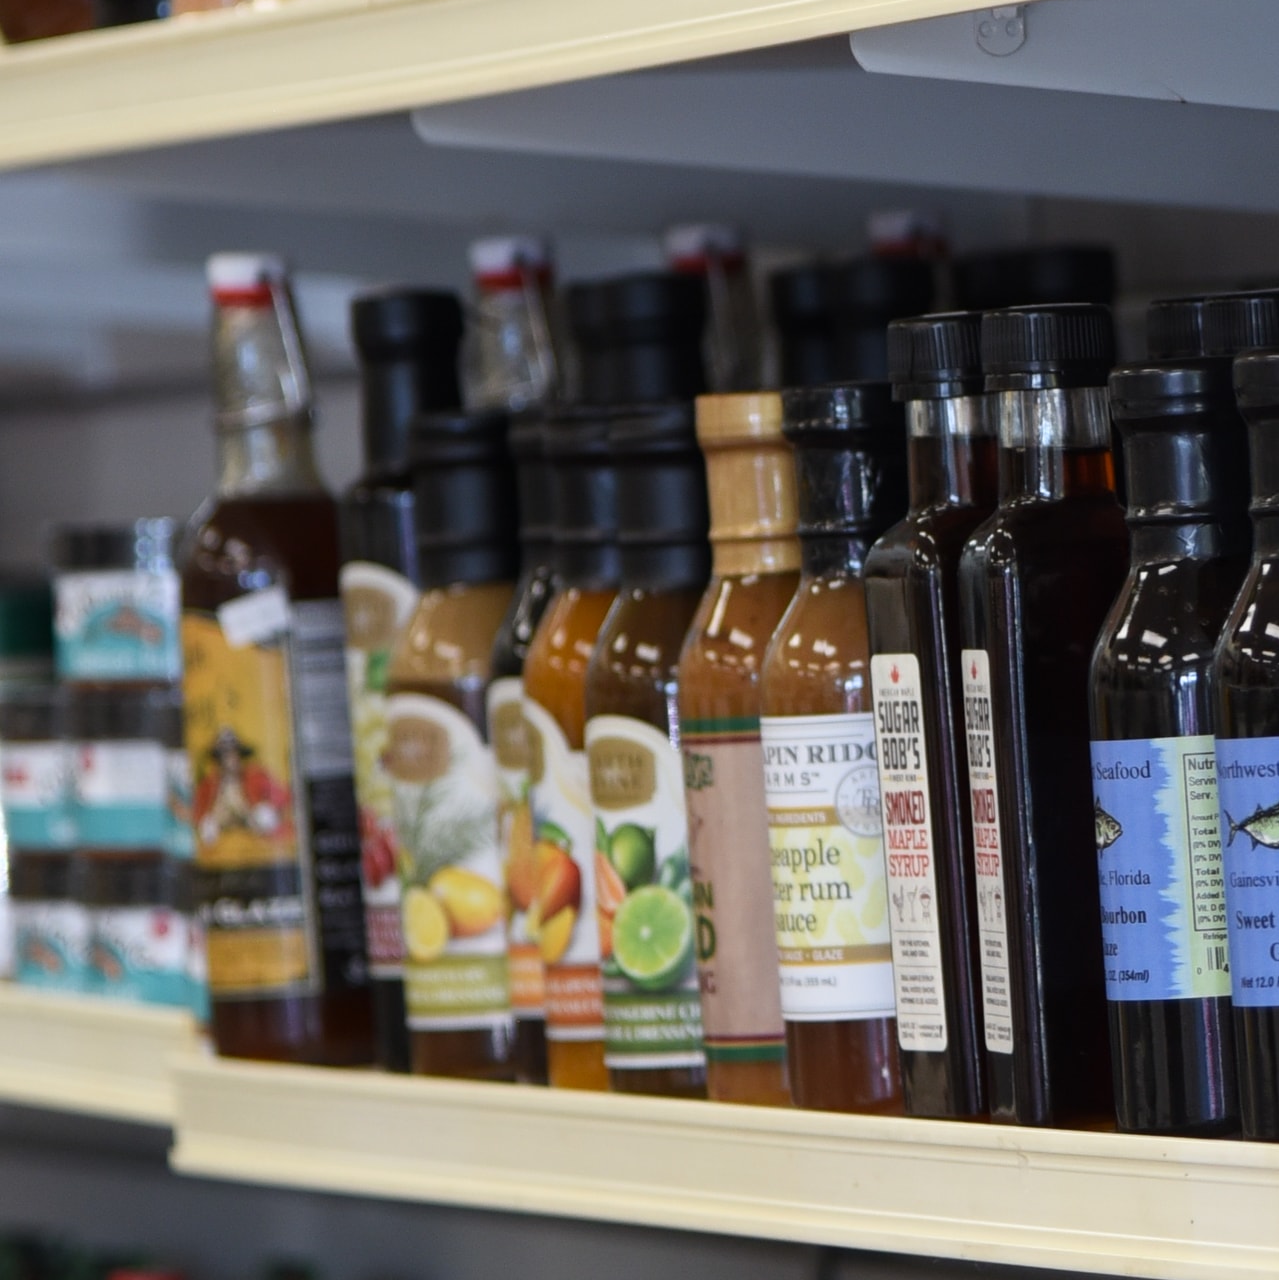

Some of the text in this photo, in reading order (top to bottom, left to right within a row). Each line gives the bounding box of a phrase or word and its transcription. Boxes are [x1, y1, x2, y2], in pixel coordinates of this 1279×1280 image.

[878, 700, 920, 734] SUGAR
[882, 737, 921, 770] BOB'S
[1096, 760, 1151, 780] Seafood
[885, 790, 925, 825] SMOKED
[888, 829, 928, 850] MAPLE
[975, 827, 999, 849] MAPLE
[1193, 827, 1217, 835] Total
[772, 838, 840, 874] eapple
[888, 854, 930, 878] SYRUP
[1109, 870, 1151, 886] Florida
[1195, 868, 1220, 876] Total
[800, 882, 853, 900] rum
[1236, 911, 1276, 930] Sweet
[1255, 975, 1274, 988] 12.0
